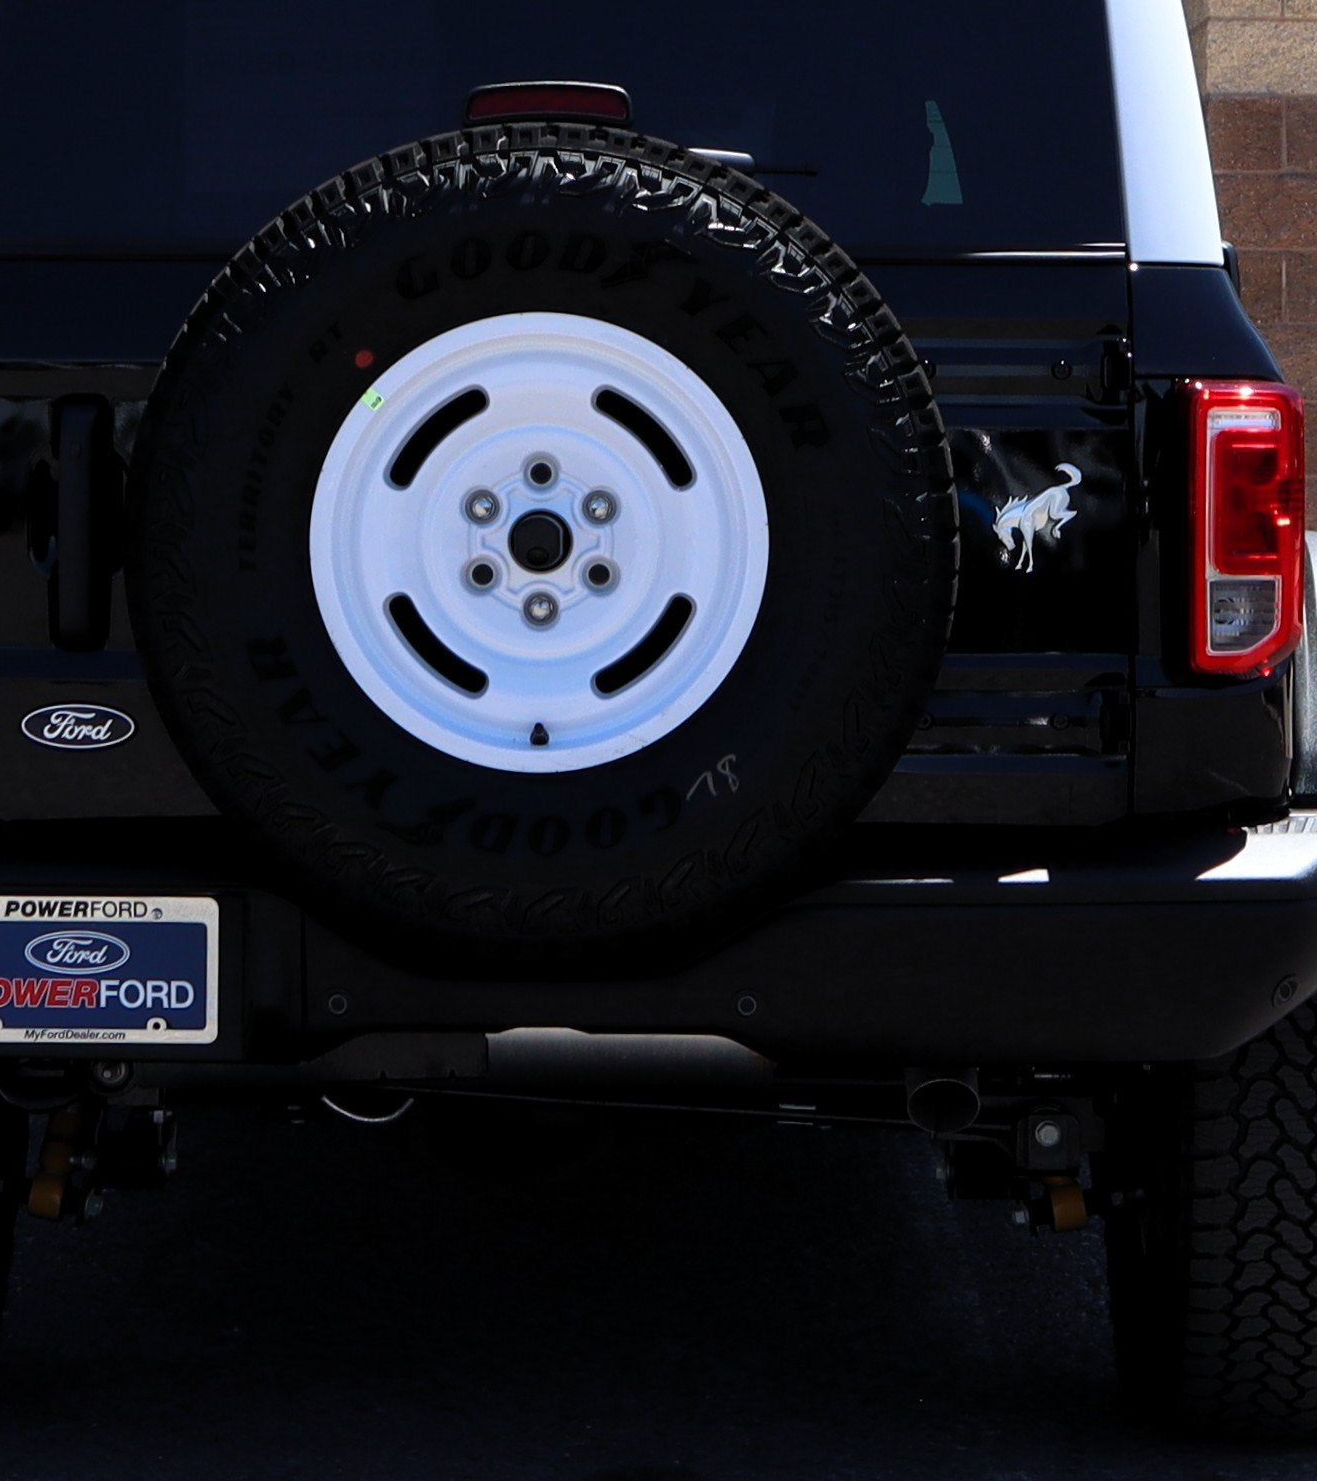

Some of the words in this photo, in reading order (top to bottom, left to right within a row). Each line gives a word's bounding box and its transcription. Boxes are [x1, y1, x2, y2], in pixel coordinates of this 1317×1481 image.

[43, 710, 113, 740] Ford
[4, 900, 148, 918] POWERFORD
[46, 938, 108, 965] Ford
[24, 1029, 126, 1041] MyFordDealer.com
